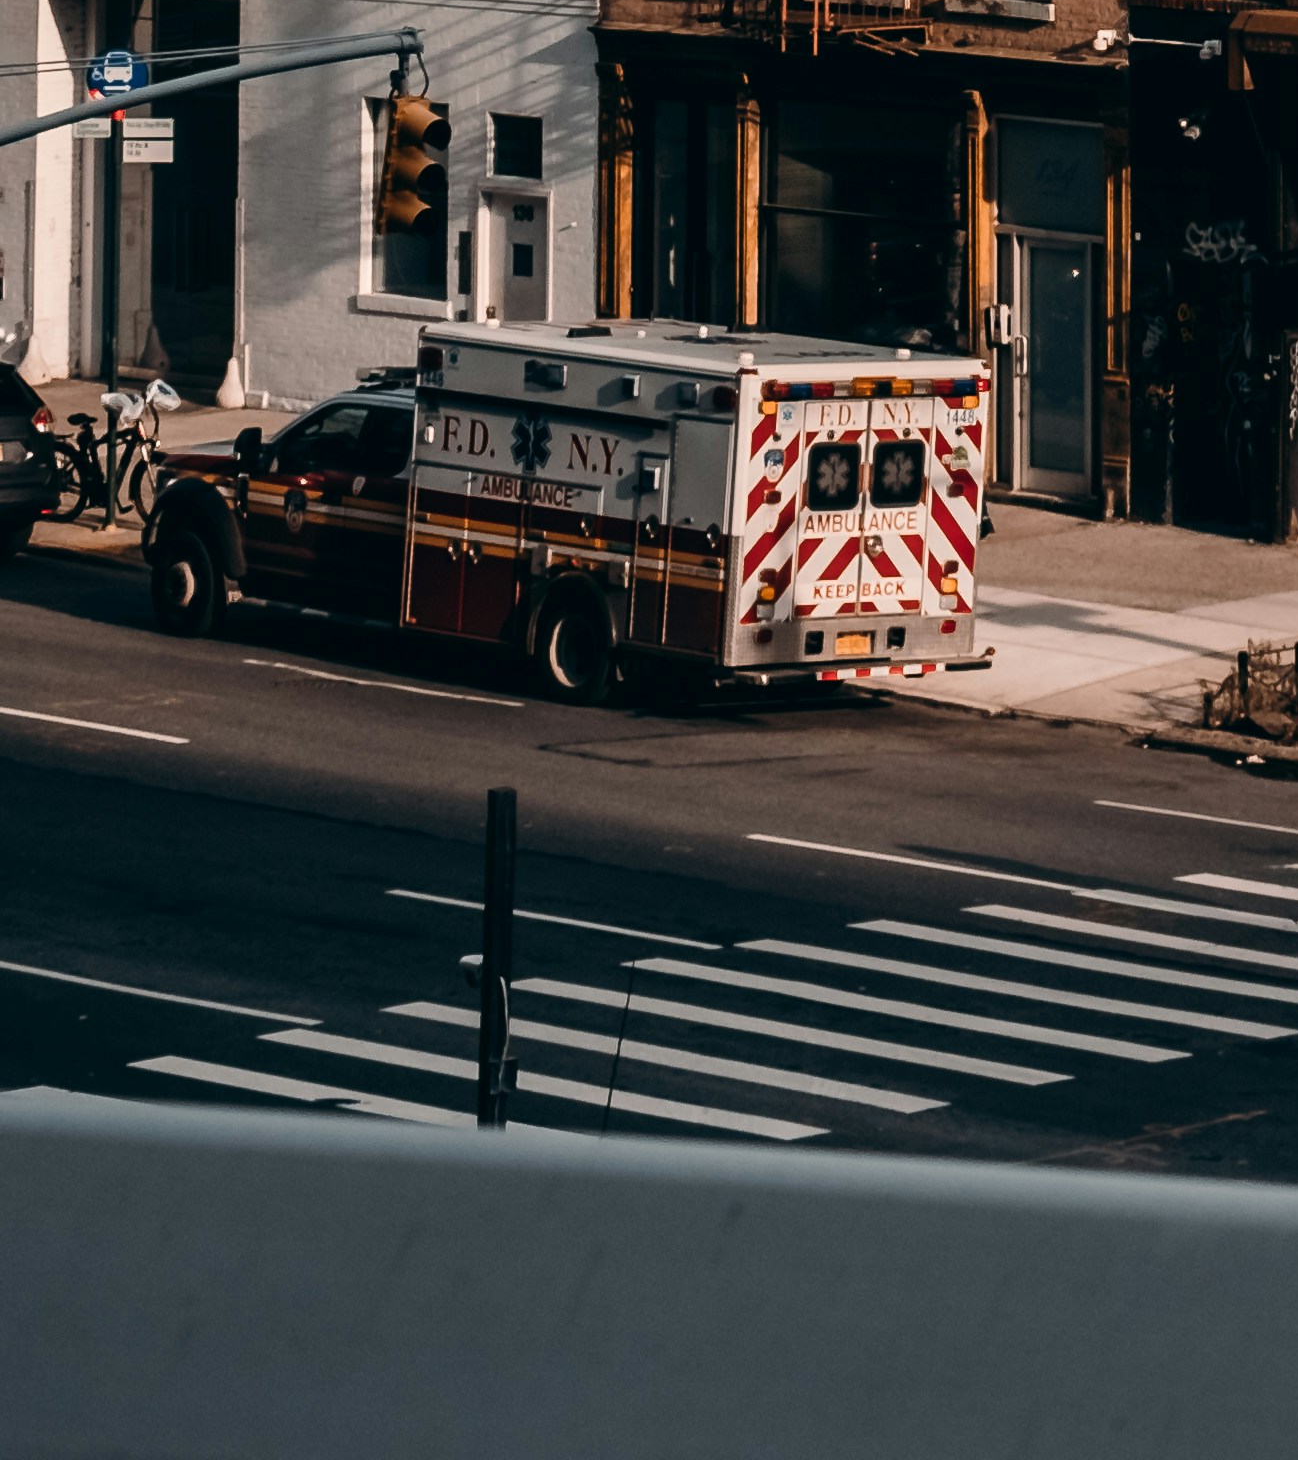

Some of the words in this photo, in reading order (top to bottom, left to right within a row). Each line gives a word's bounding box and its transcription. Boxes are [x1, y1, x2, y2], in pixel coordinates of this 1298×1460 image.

[820, 404, 856, 427] F.D.
[882, 403, 919, 426] N.Y.
[946, 409, 976, 425] 1448
[441, 415, 495, 458] F.D.
[566, 432, 624, 476] N.Y.
[804, 510, 917, 532] AMBULANCE
[813, 583, 854, 599] KEEP
[861, 581, 906, 597] BACK
